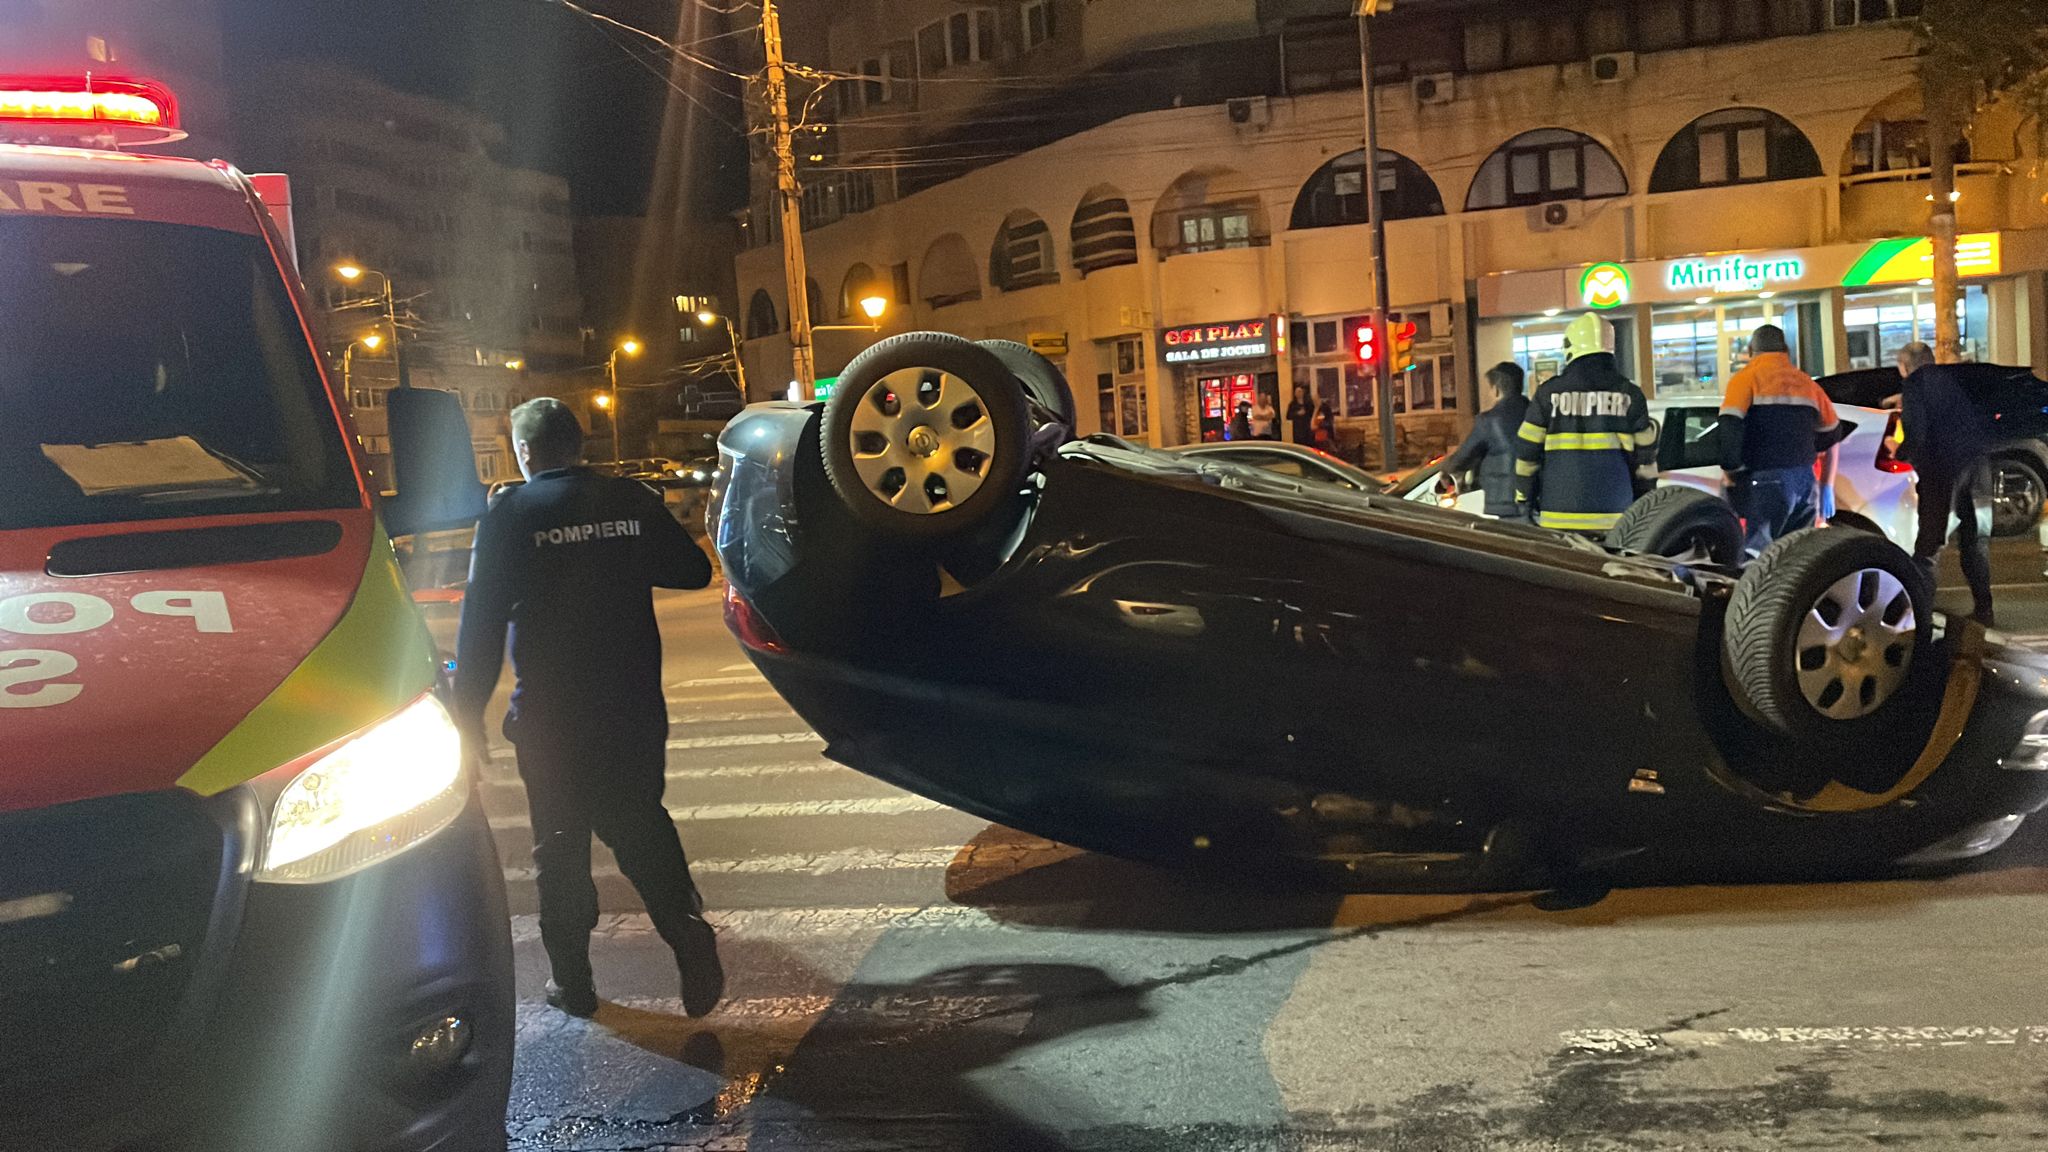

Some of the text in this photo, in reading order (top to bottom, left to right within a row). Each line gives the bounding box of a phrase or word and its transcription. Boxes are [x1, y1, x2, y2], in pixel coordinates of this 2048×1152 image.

[1671, 258, 1800, 286] Minifarm
[1206, 322, 1264, 341] PLAY
[1165, 343, 1266, 361] SALA DE JOCURI
[533, 519, 641, 547] POMPIERII
